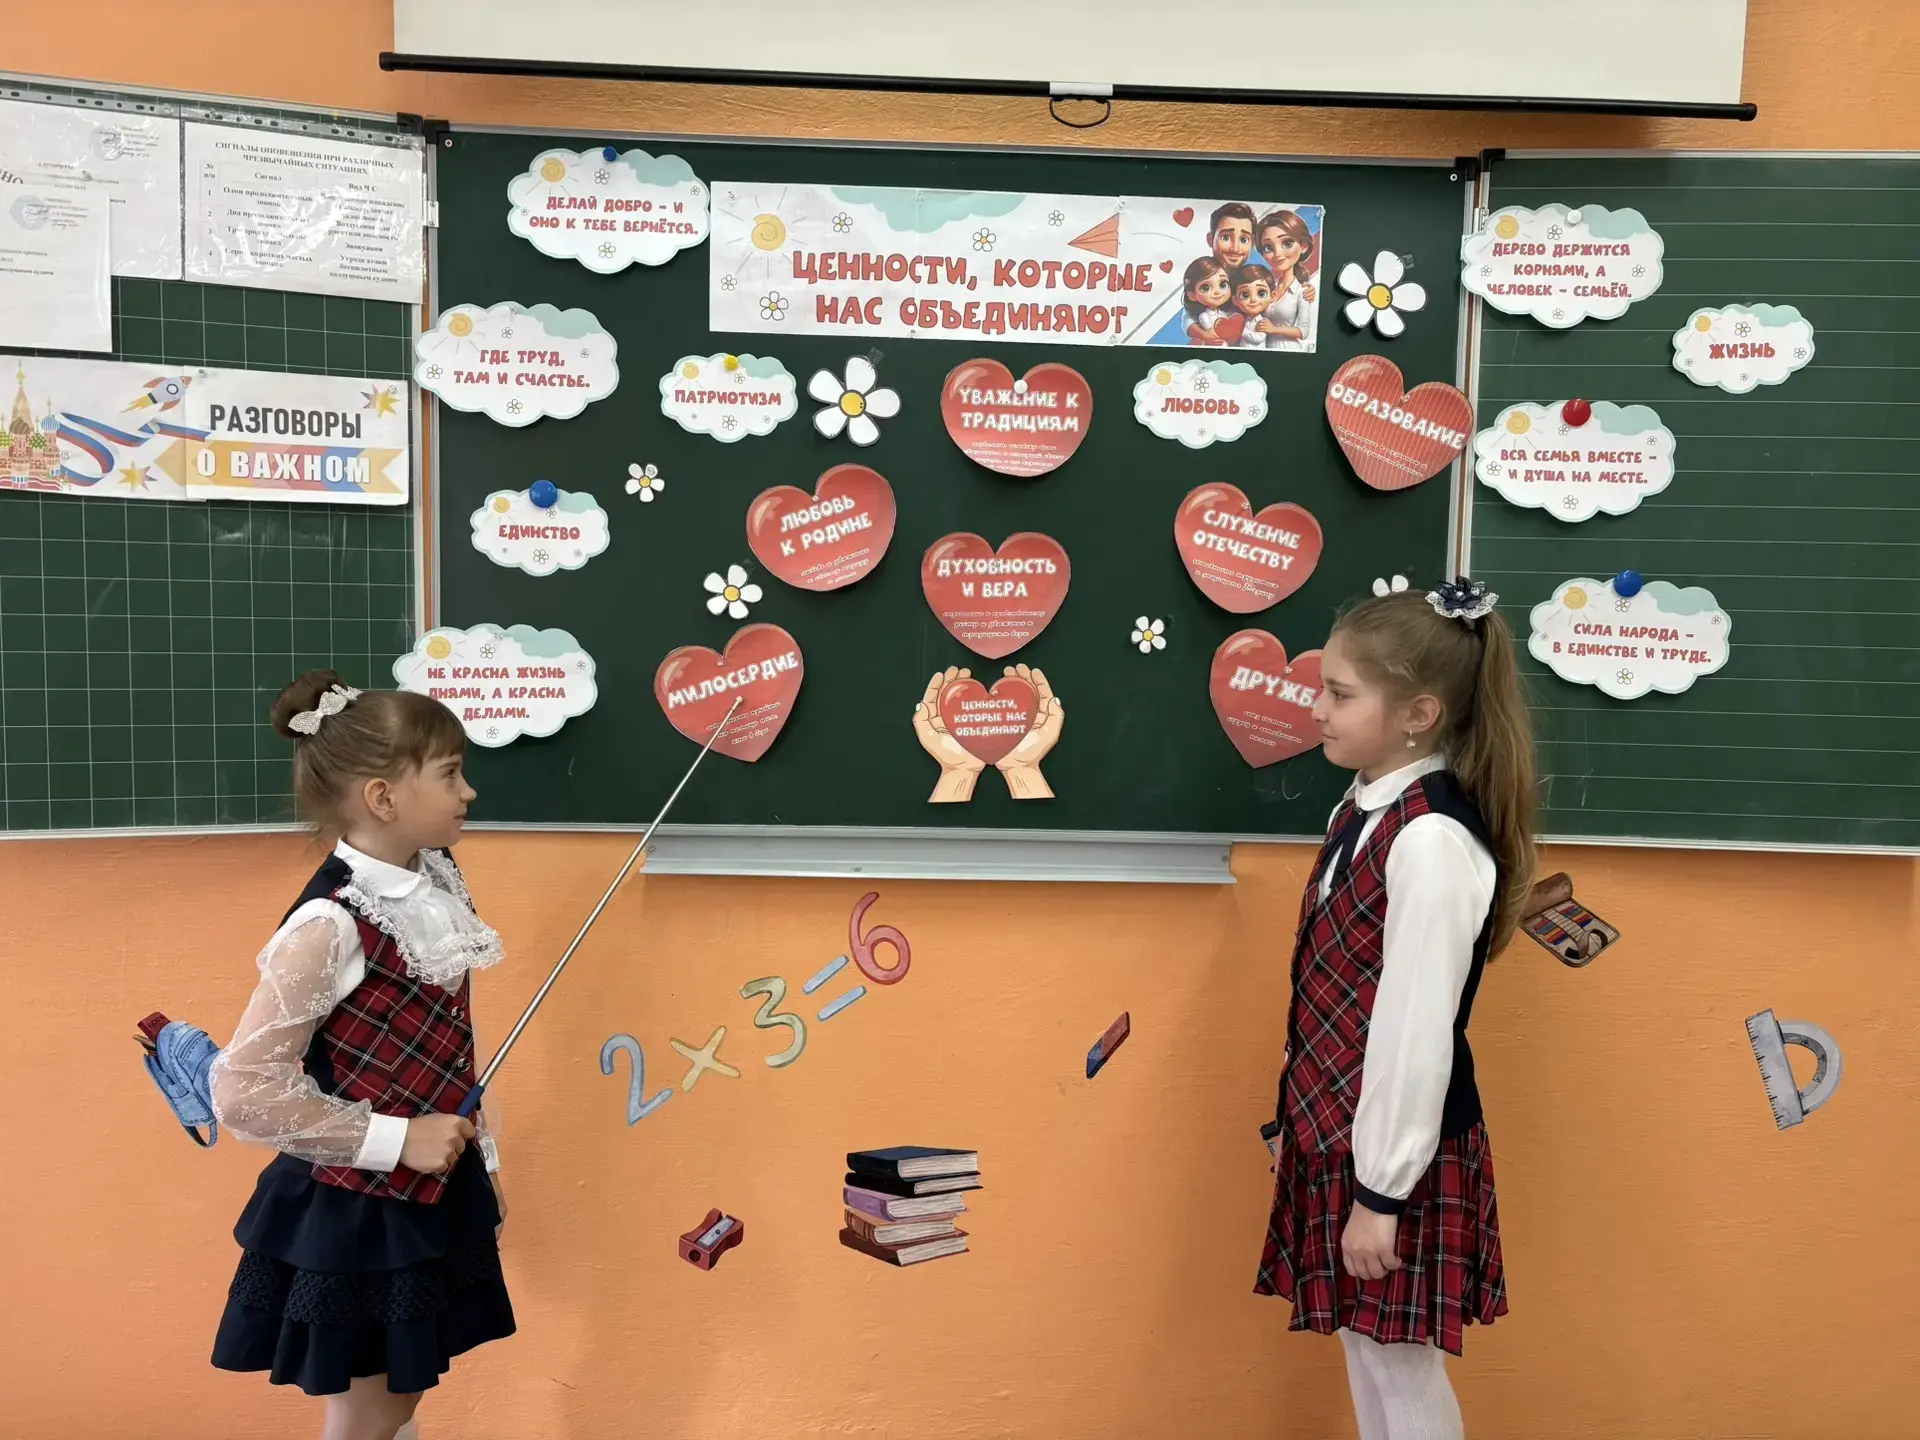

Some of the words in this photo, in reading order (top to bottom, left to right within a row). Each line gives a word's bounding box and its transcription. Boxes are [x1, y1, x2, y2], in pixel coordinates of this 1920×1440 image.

[215, 141, 258, 153] СИГНАЛЫ
[260, 147, 322, 160] ОПОВЕЩЕНИЯ
[324, 154, 341, 162] ПРИ
[343, 156, 394, 169] РАЗЛИЧНЫХ
[243, 154, 314, 169] ЧРЕЗВЫЧАЙНЫХ
[315, 163, 368, 175] СИТУАЦИЯХ
[546, 196, 598, 210] ДЕЛАЙ
[603, 199, 653, 213] ДОБРО
[673, 202, 684, 214] И
[529, 216, 560, 228] ОНО
[566, 217, 576, 230] К
[583, 218, 617, 232] ТЕБЕ
[623, 218, 699, 235] ВЕРНЁТСЯ.
[1492, 243, 1546, 257] ДЕРЕВО
[1552, 243, 1631, 258] ДЕРЖИТСЯ
[792, 250, 978, 291] ЦЕННОСТИ,
[993, 258, 1153, 293] КОТОРЫЕ
[1513, 264, 1589, 279] КОРНЯМИ,
[1595, 265, 1606, 277] А
[1486, 283, 1552, 297] ЧЕЛОВЕК
[1573, 281, 1632, 299] СЕМЬЁЙ.
[815, 294, 883, 325] НАС
[899, 297, 1128, 335] ОБЪЕДИНЯЮТ
[479, 349, 510, 364] ГДЕ
[517, 350, 565, 367] ТРУД,
[1708, 342, 1776, 360] ЖИЗНЬ
[453, 370, 491, 385] ТАМ
[497, 372, 508, 386] И
[515, 372, 591, 389] СЧАСТЬЕ.
[674, 389, 782, 406] ПАТРИОТИЗМ
[959, 387, 1058, 408] УВАЖЕНИЕ
[1066, 392, 1080, 409] К
[1160, 397, 1240, 415] ЛЮБОВЬ
[209, 404, 362, 439] РАЗГОВОРЫ
[960, 412, 1079, 433] ТРАДИЦИЯМ
[1330, 383, 1467, 449] ОБРАЗОВАНИЕ
[196, 448, 216, 477] О
[230, 450, 371, 484] ВАЖНОМ
[1500, 449, 1527, 461] ВСЯ
[1533, 450, 1581, 462] СЕМЬЯ
[1587, 451, 1642, 464] ВМЕСТЕ
[1508, 468, 1518, 480] И
[1524, 469, 1565, 482] ДУША
[1571, 470, 1592, 483] НА
[1598, 471, 1648, 485] МЕСТЕ.
[780, 494, 856, 533] ЛЮБОВЬ
[498, 524, 581, 541] ЕДИНСТВО
[780, 539, 796, 557] К
[800, 511, 873, 550] РОДИНЕ
[1202, 509, 1302, 549] СЛУЖЕНИЕ
[1192, 529, 1295, 571] ОТЕЧЕСТВУ
[937, 557, 1057, 577] ДУХОВНОСТЬ
[961, 582, 974, 598] И
[982, 581, 1028, 598] ВЕРА
[1573, 623, 1613, 637] СИЛА
[1619, 625, 1679, 642] НАРОДА
[1552, 641, 1562, 654] В
[1567, 642, 1638, 658] ЕДИНСТВЕ
[1645, 647, 1655, 659] И
[1661, 648, 1712, 664] ТРУДЕ.
[427, 667, 446, 679] НЕ
[452, 667, 510, 679] КРАСНА
[516, 666, 566, 679] ЖИЗНЬ
[667, 651, 799, 709] МИЛОСЕРДИЕ
[429, 687, 485, 700] ДНЯМИ,
[491, 687, 503, 699] А
[508, 687, 566, 699] КРАСНА
[1228, 665, 1320, 708] ДРУЖБ
[462, 707, 530, 721] ДЕЛАМИ.
[961, 699, 1018, 711] ЦЕННОСТИ,
[954, 713, 1002, 723] КОТОРЫЕ
[1006, 711, 1027, 721] НАС
[955, 725, 1026, 737] ОБЪЕДИНЯЮТ
